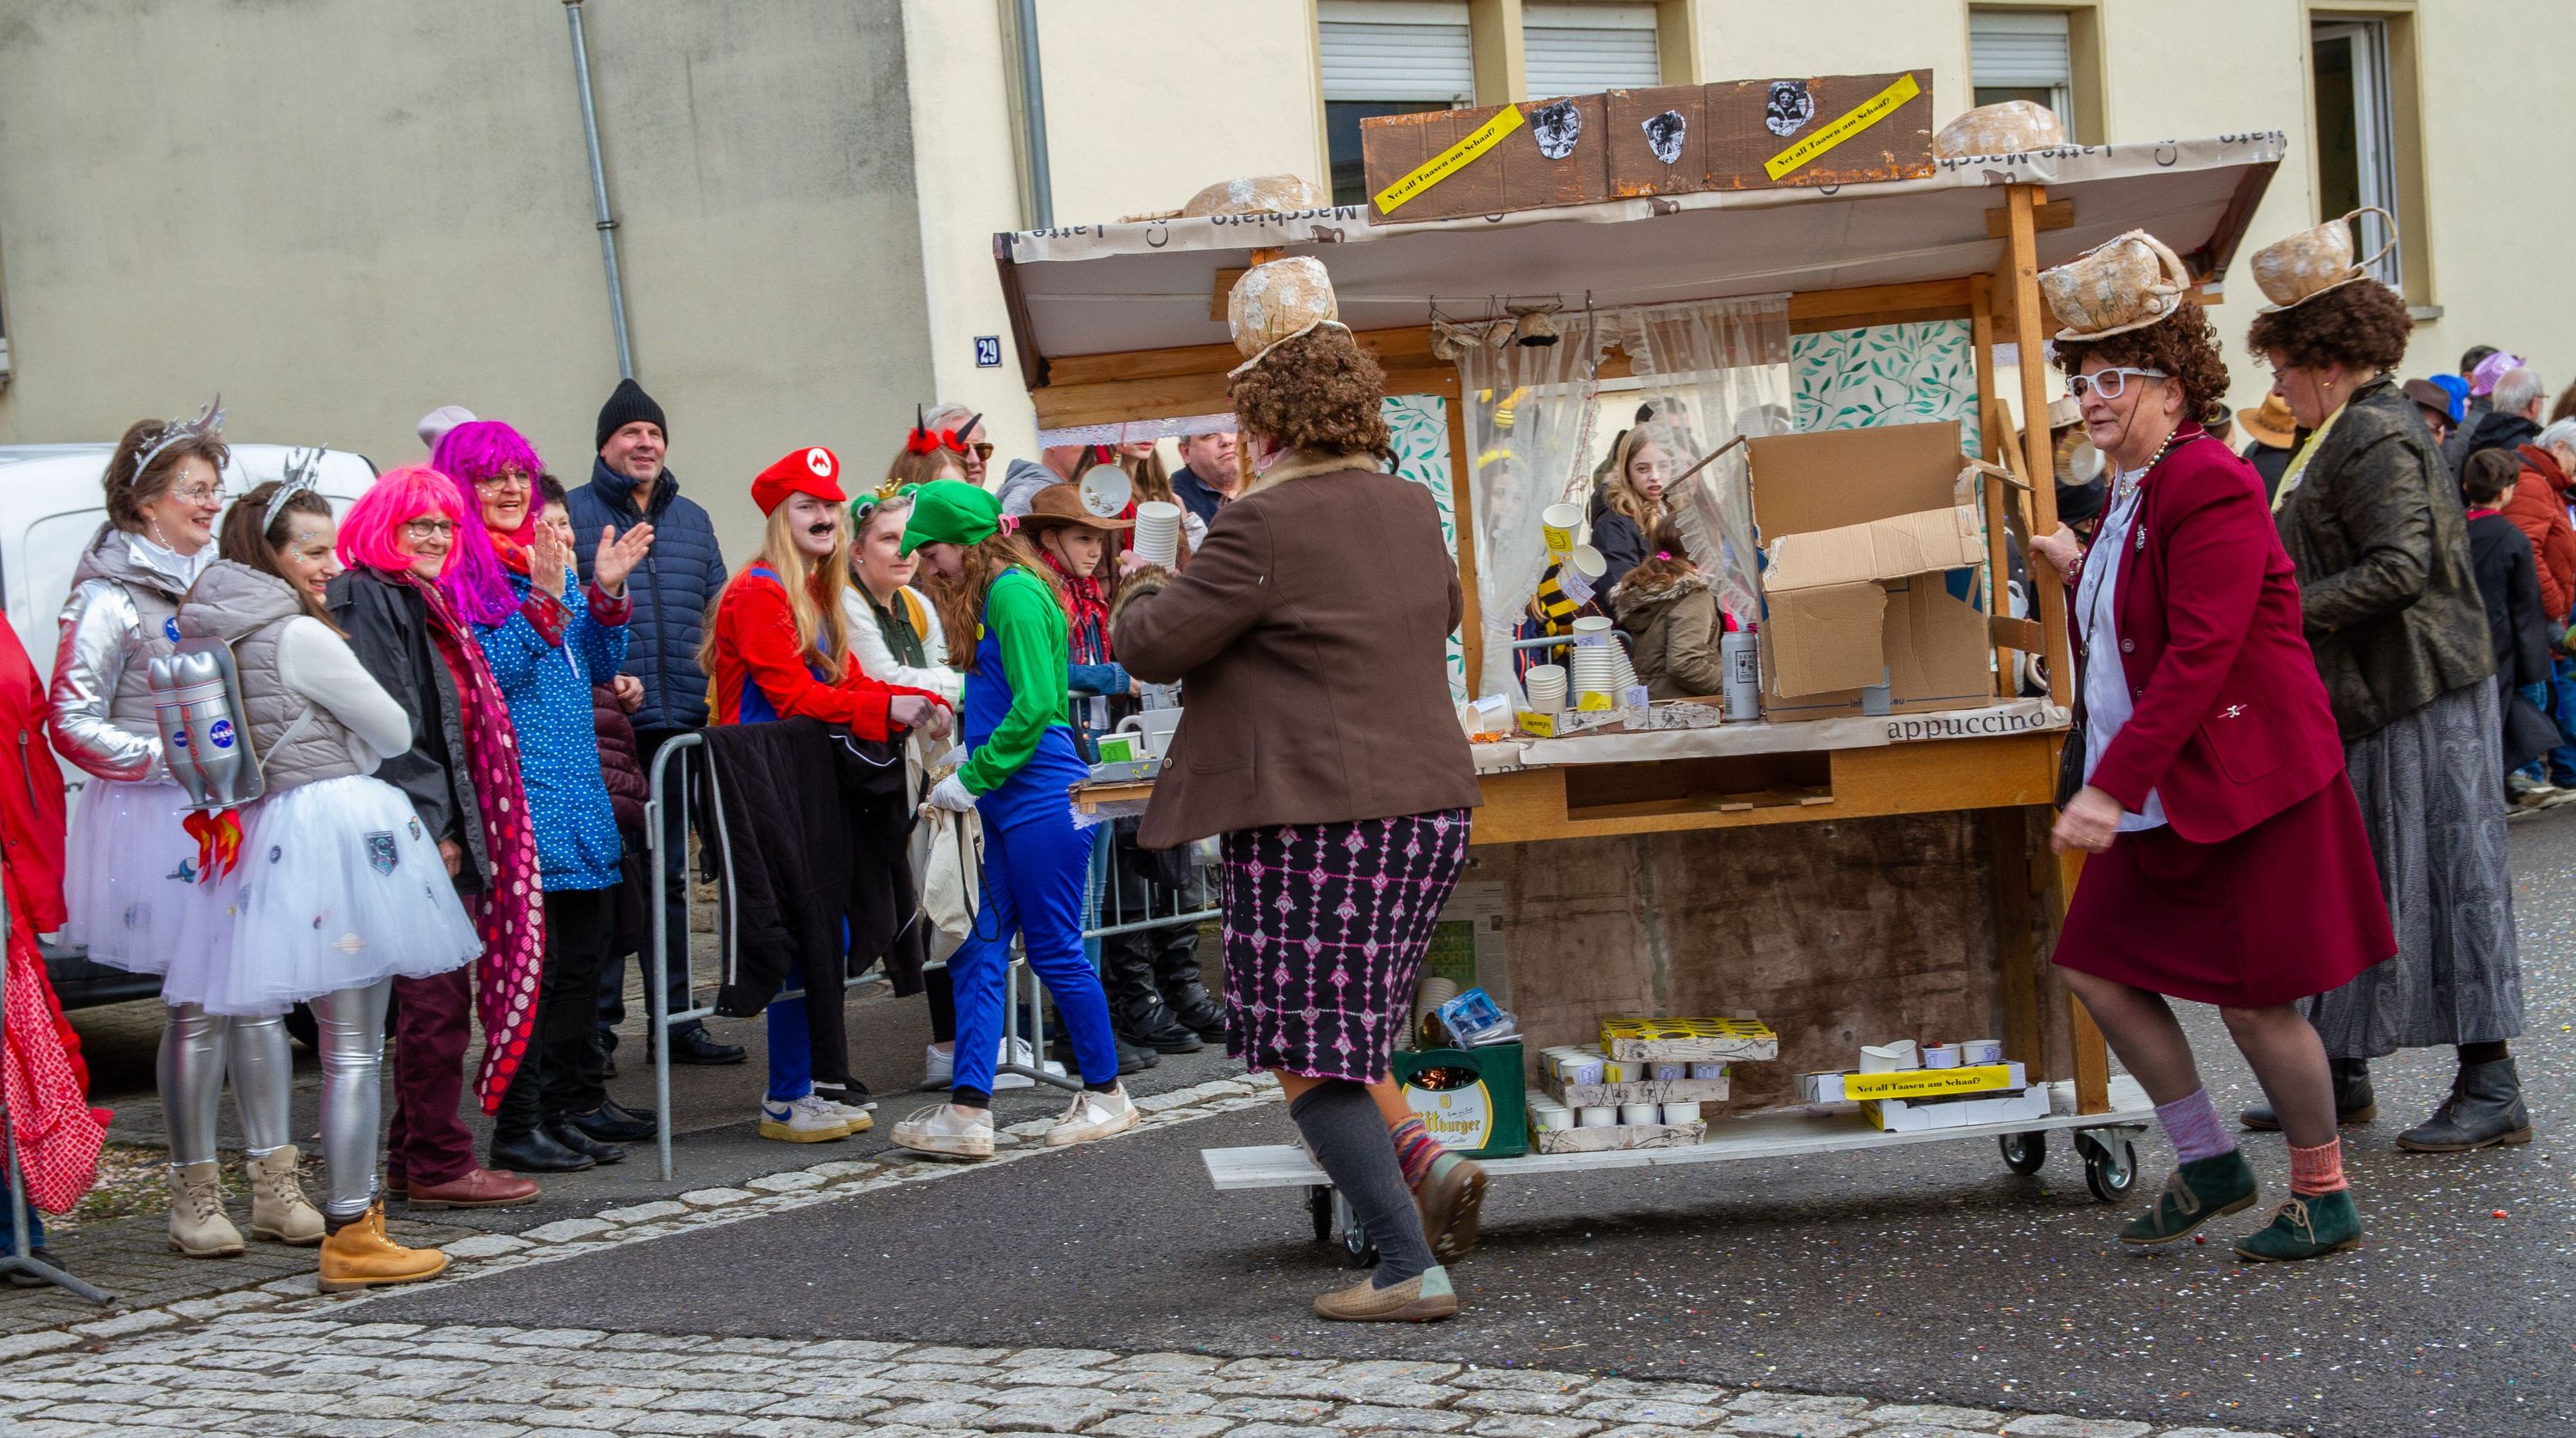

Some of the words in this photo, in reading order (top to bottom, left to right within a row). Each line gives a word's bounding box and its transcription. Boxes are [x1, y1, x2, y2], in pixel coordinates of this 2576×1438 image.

[1795, 146, 1807, 157] all
[1807, 129, 1840, 149] Taasen
[1843, 119, 1856, 130] am
[1857, 97, 1890, 121] Schaaf?
[1405, 179, 1417, 191] all
[1416, 161, 1449, 182] Taasen
[1449, 151, 1464, 162] am
[1464, 127, 1495, 152] Schaaf?
[979, 339, 998, 363] 29
[812, 453, 830, 469] M
[1887, 711, 2045, 740] appuccino
[1945, 1077, 1981, 1087] Schaaf?
